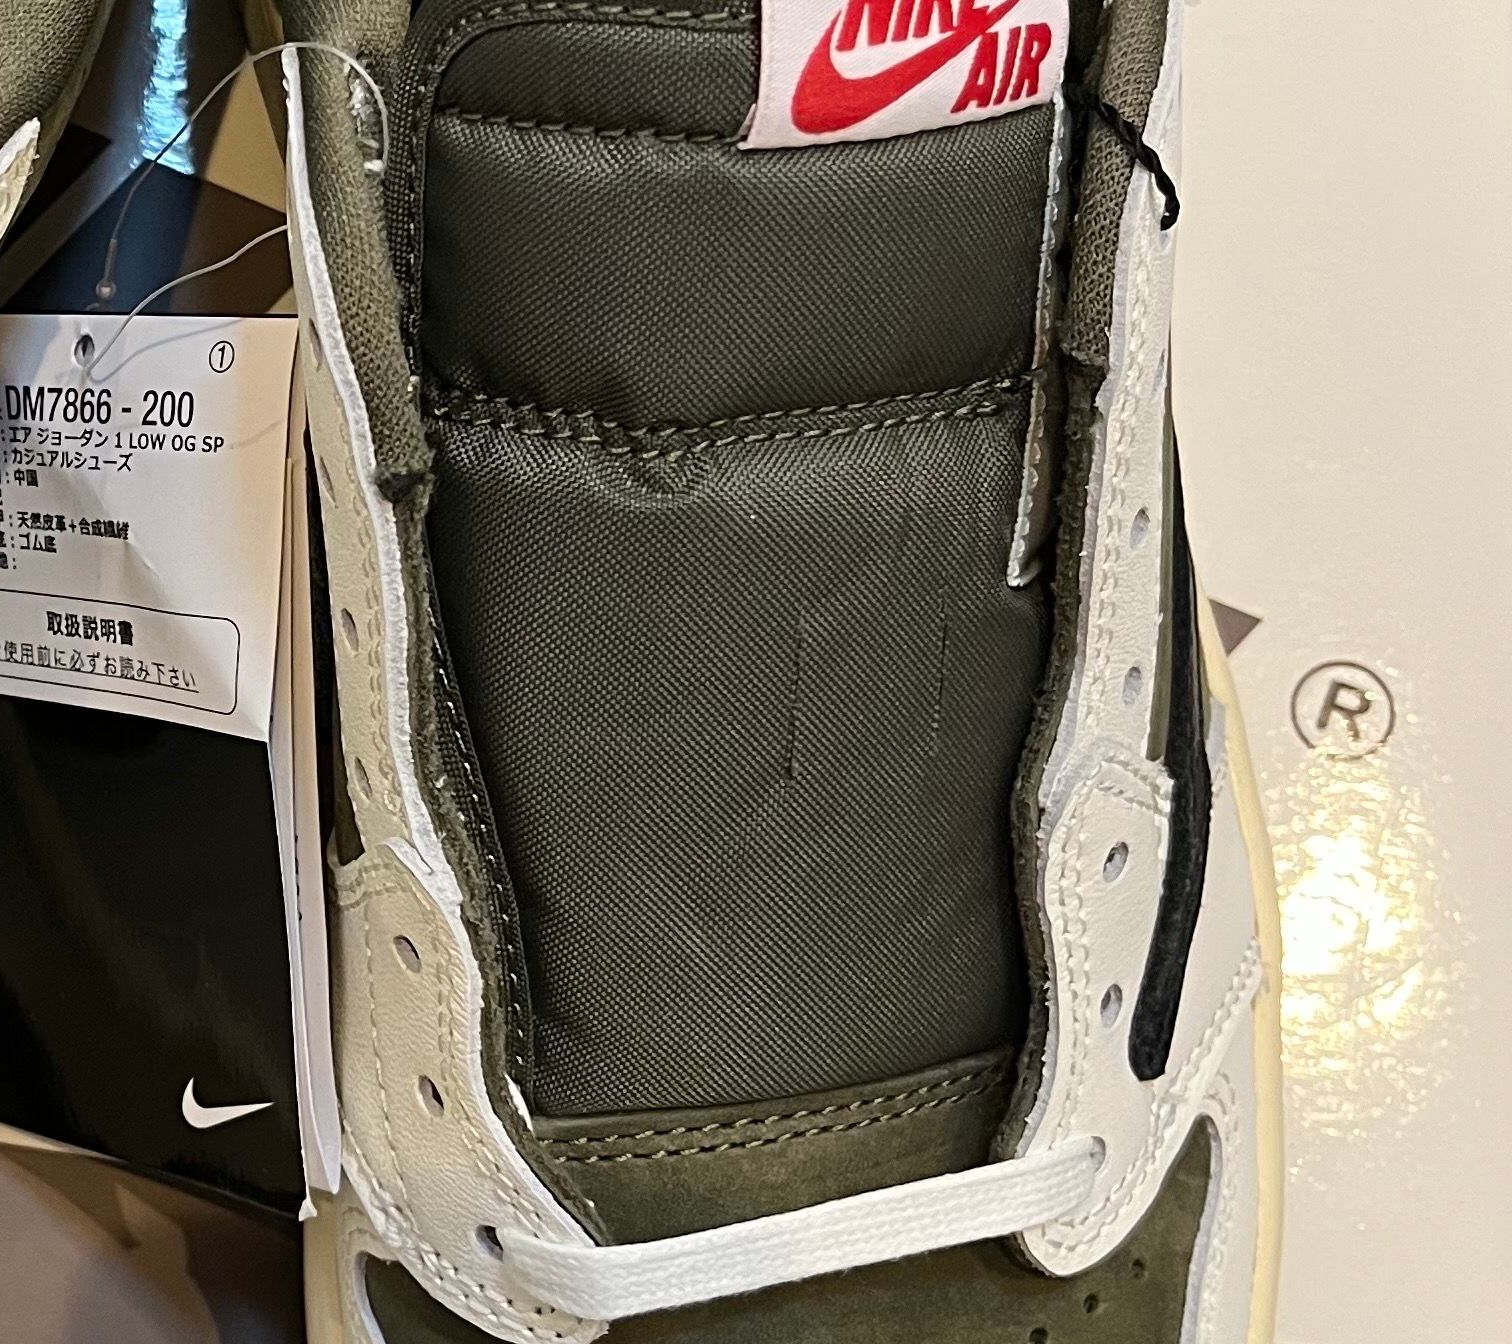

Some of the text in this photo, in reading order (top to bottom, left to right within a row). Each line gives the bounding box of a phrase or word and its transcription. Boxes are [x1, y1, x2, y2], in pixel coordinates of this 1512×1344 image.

[949, 22, 1053, 115] AIR
[5, 384, 113, 425] DM7866
[141, 389, 195, 428] 200
[128, 432, 166, 451] LOW
[171, 434, 197, 453] OG
[201, 435, 225, 454] SP
[45, 610, 134, 647] 取扱説明書
